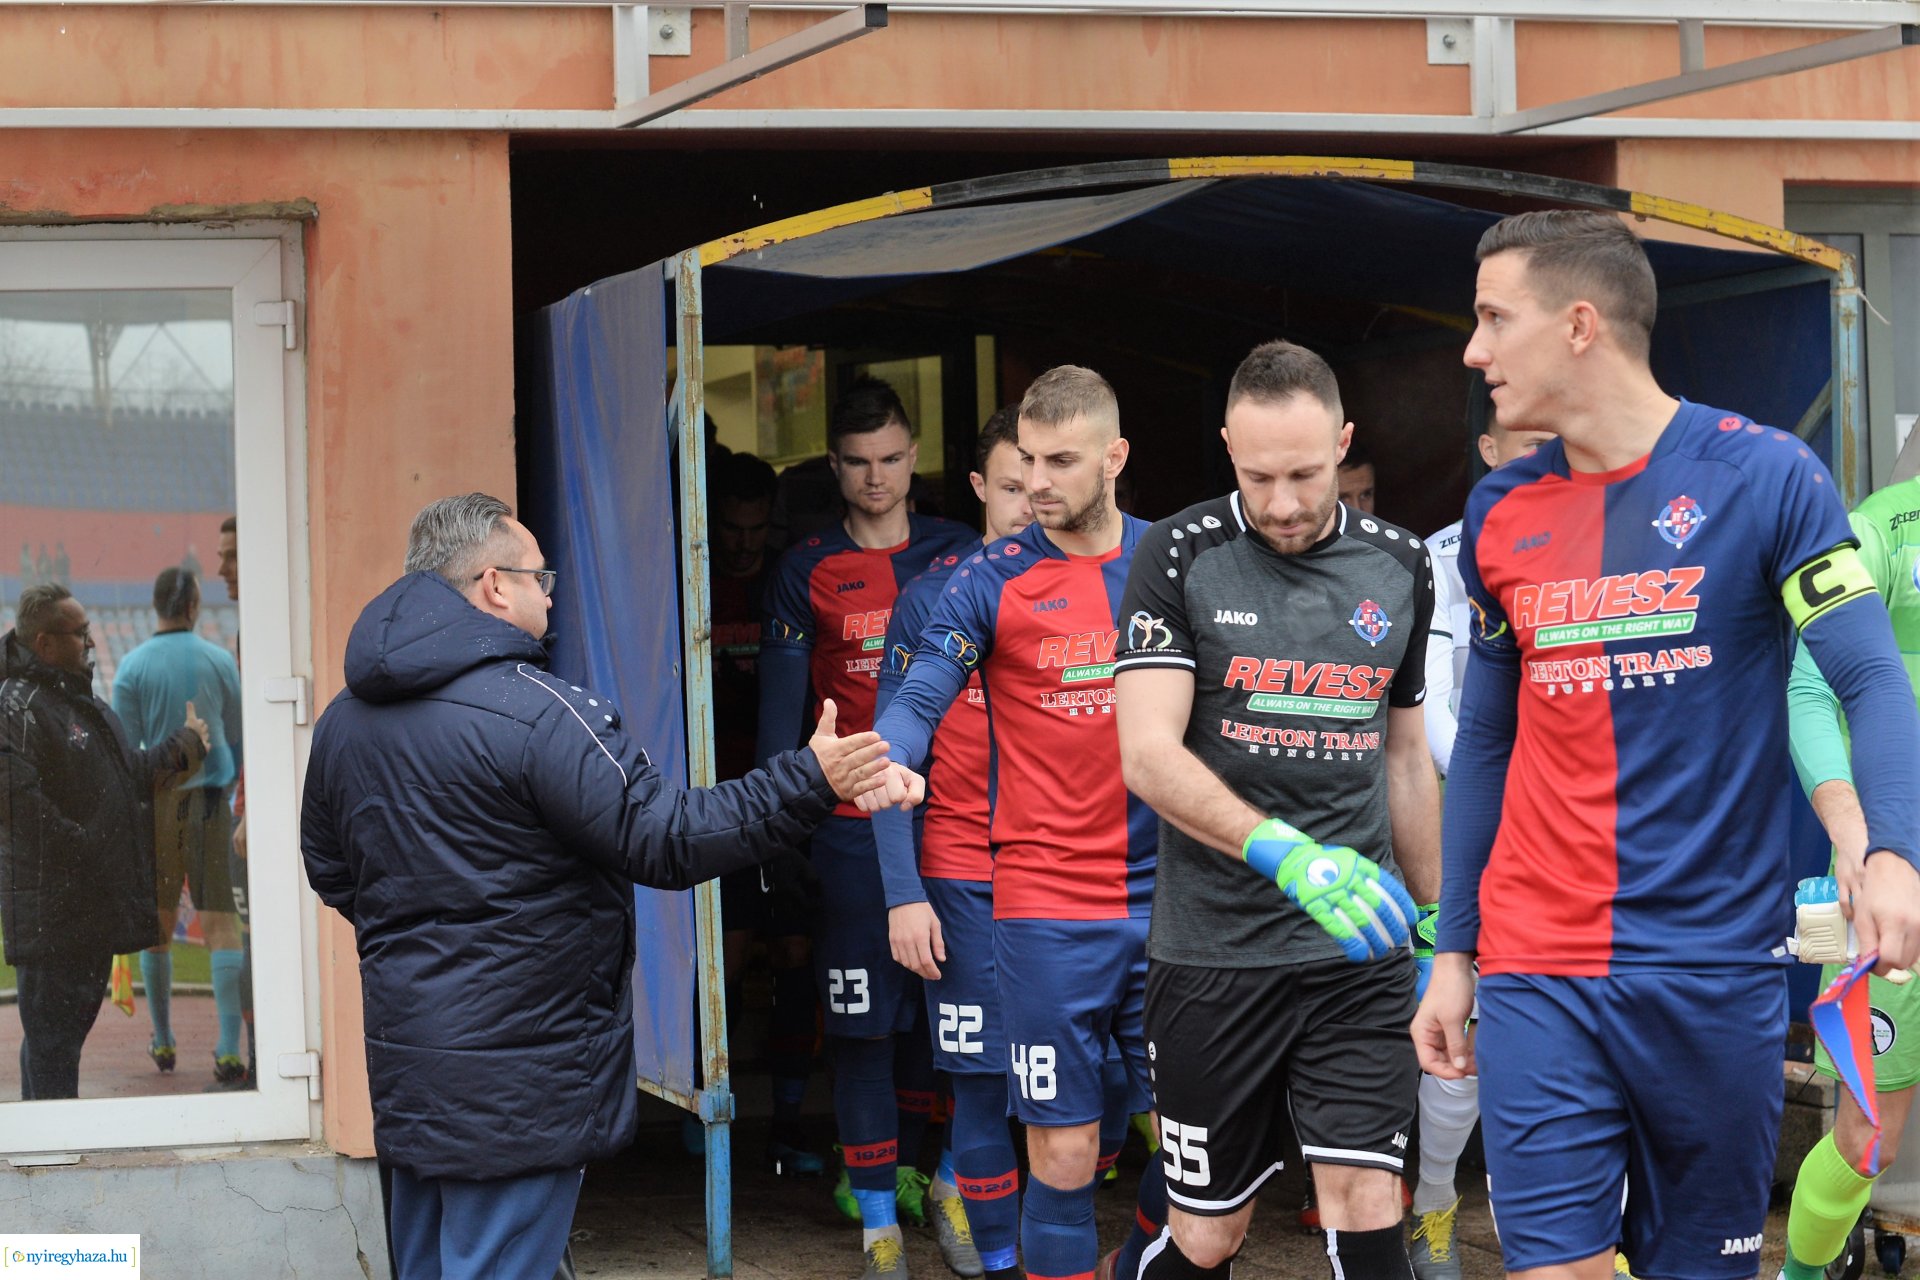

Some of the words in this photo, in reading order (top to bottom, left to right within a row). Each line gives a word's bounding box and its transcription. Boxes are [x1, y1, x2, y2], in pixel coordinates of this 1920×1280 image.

[837, 581, 865, 593] JAKO
[1514, 566, 1705, 629] REVESZ
[1799, 559, 1846, 608] C
[1033, 598, 1068, 612] JAKO
[1213, 609, 1258, 626] JAKO
[1538, 628, 1580, 643] ALWAYS
[1581, 626, 1600, 638] ON
[1601, 624, 1623, 635] THE
[1624, 620, 1660, 633] RIGHT
[1662, 617, 1691, 630] WAY
[1065, 667, 1101, 679] ALWAYS
[1614, 645, 1713, 676] TRANS
[1223, 656, 1395, 699] REVESZ
[1253, 698, 1294, 709] ALWAYS
[1296, 702, 1310, 710] ON
[1312, 702, 1331, 712] THE
[1333, 704, 1361, 714] RIGHT
[1361, 705, 1376, 715] WAY
[1220, 719, 1316, 748] LERTON
[1320, 731, 1380, 750] TRANS
[1249, 744, 1363, 761] HUNGARY
[828, 967, 870, 1014] 23
[938, 1002, 984, 1053] 22
[1011, 1043, 1057, 1101] 48
[1160, 1115, 1211, 1187] 55
[1720, 1233, 1763, 1255] JAKO
